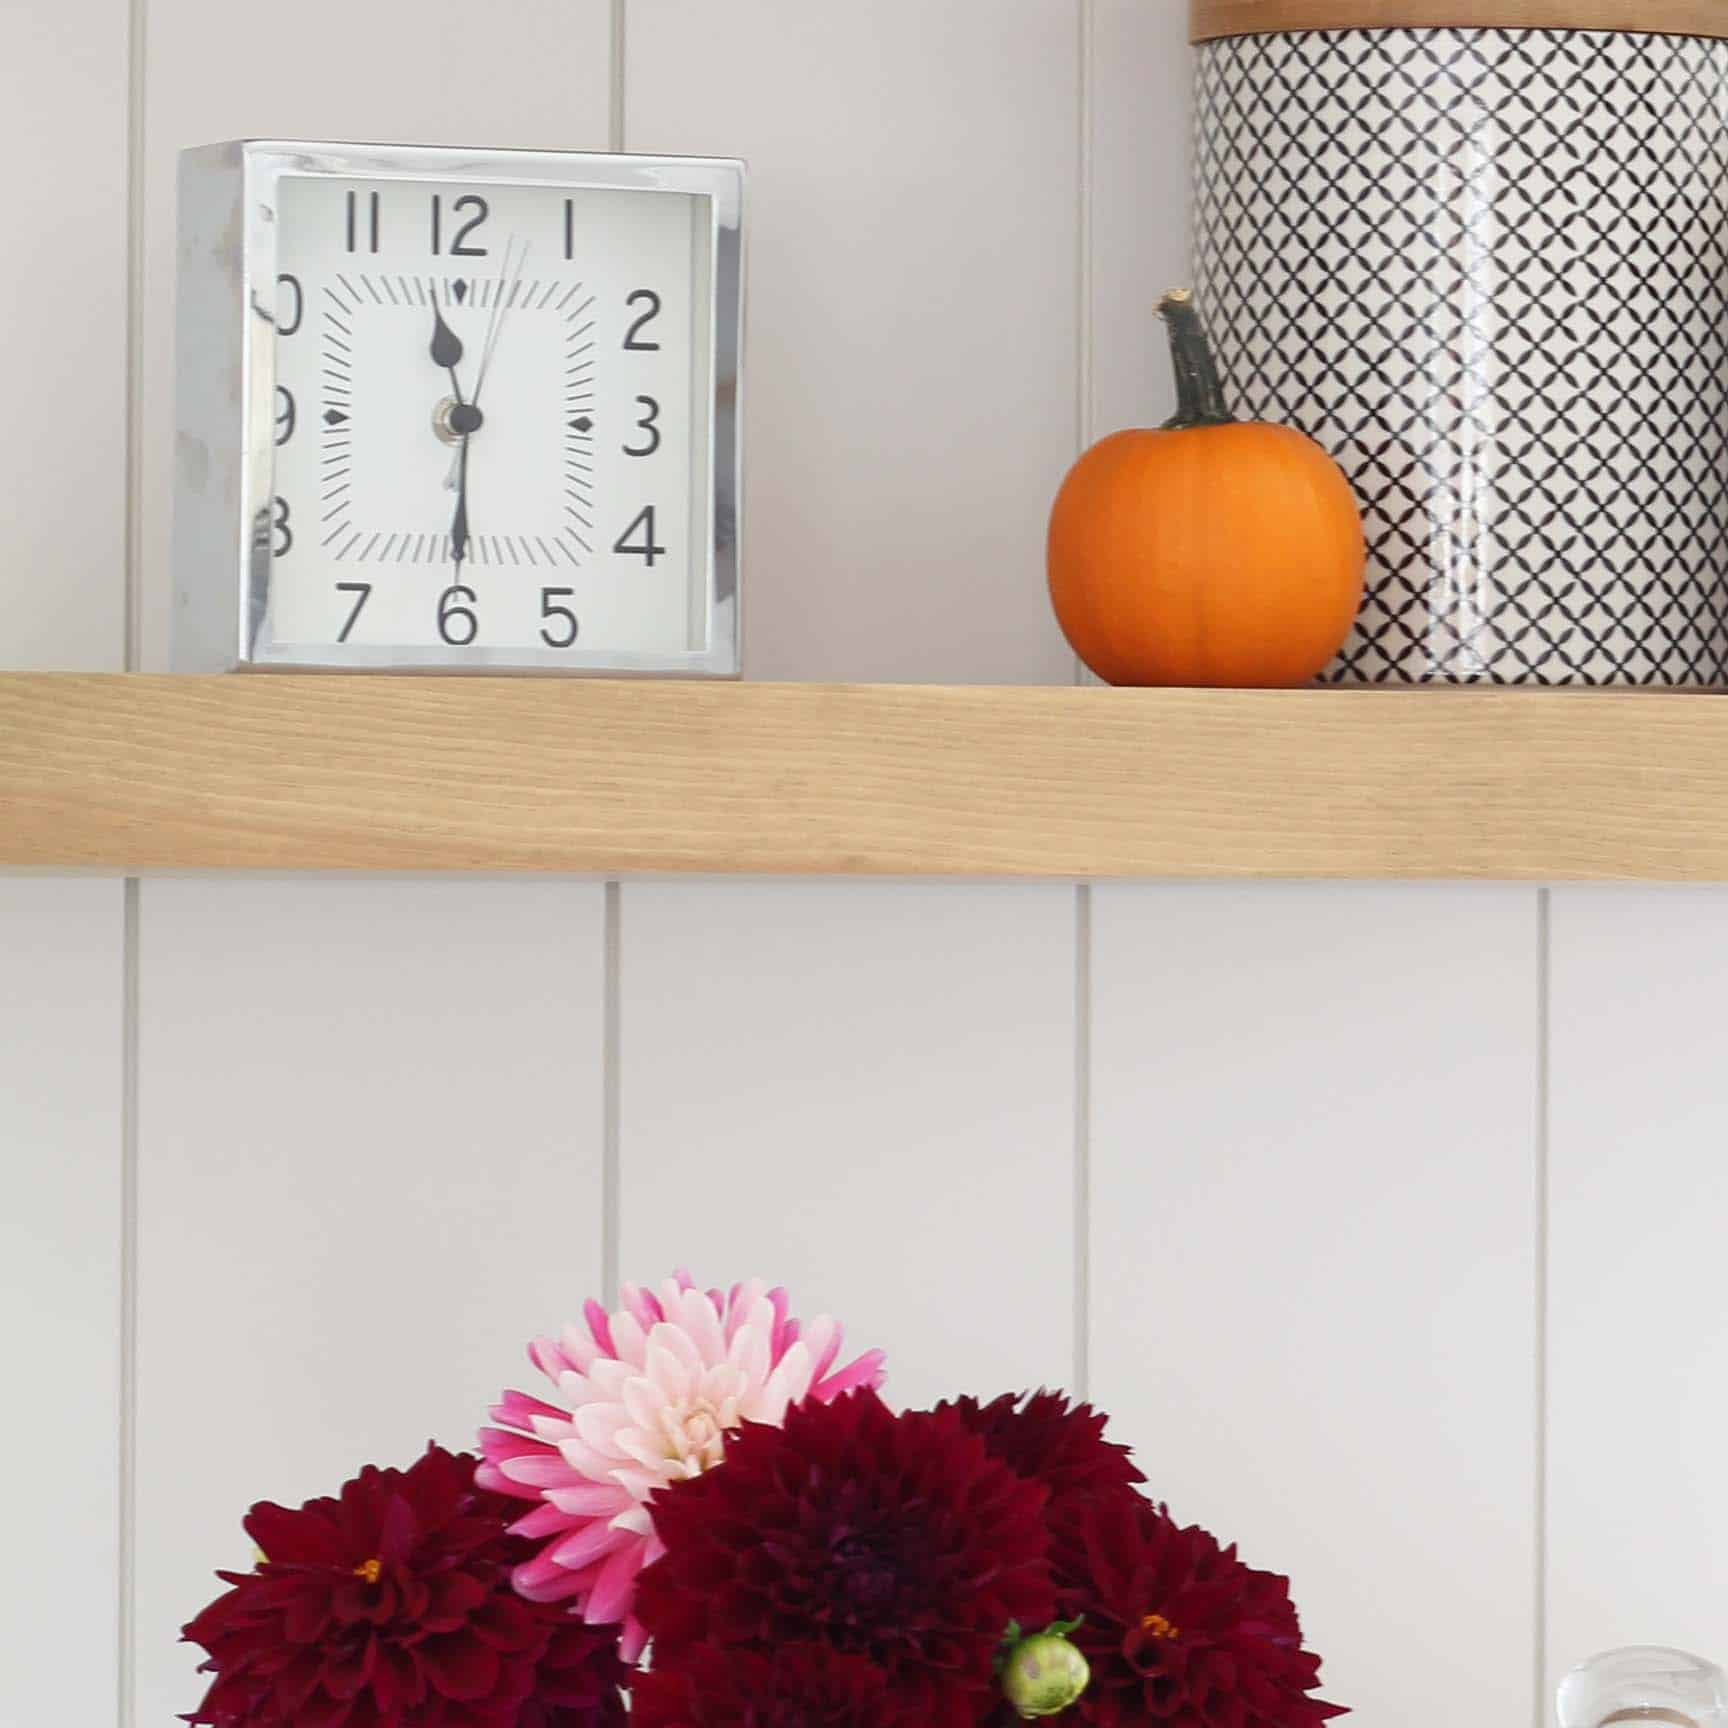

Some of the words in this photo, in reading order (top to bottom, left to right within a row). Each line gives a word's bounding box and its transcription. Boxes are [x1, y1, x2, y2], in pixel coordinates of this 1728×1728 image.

[346, 190, 379, 254] 11
[431, 194, 489, 257] 12
[564, 198, 574, 261] 1
[624, 289, 662, 352] 2
[621, 395, 662, 458] 3
[612, 505, 667, 568] 4
[335, 582, 373, 644] 7
[437, 585, 479, 647] 6
[540, 586, 580, 649] 5
